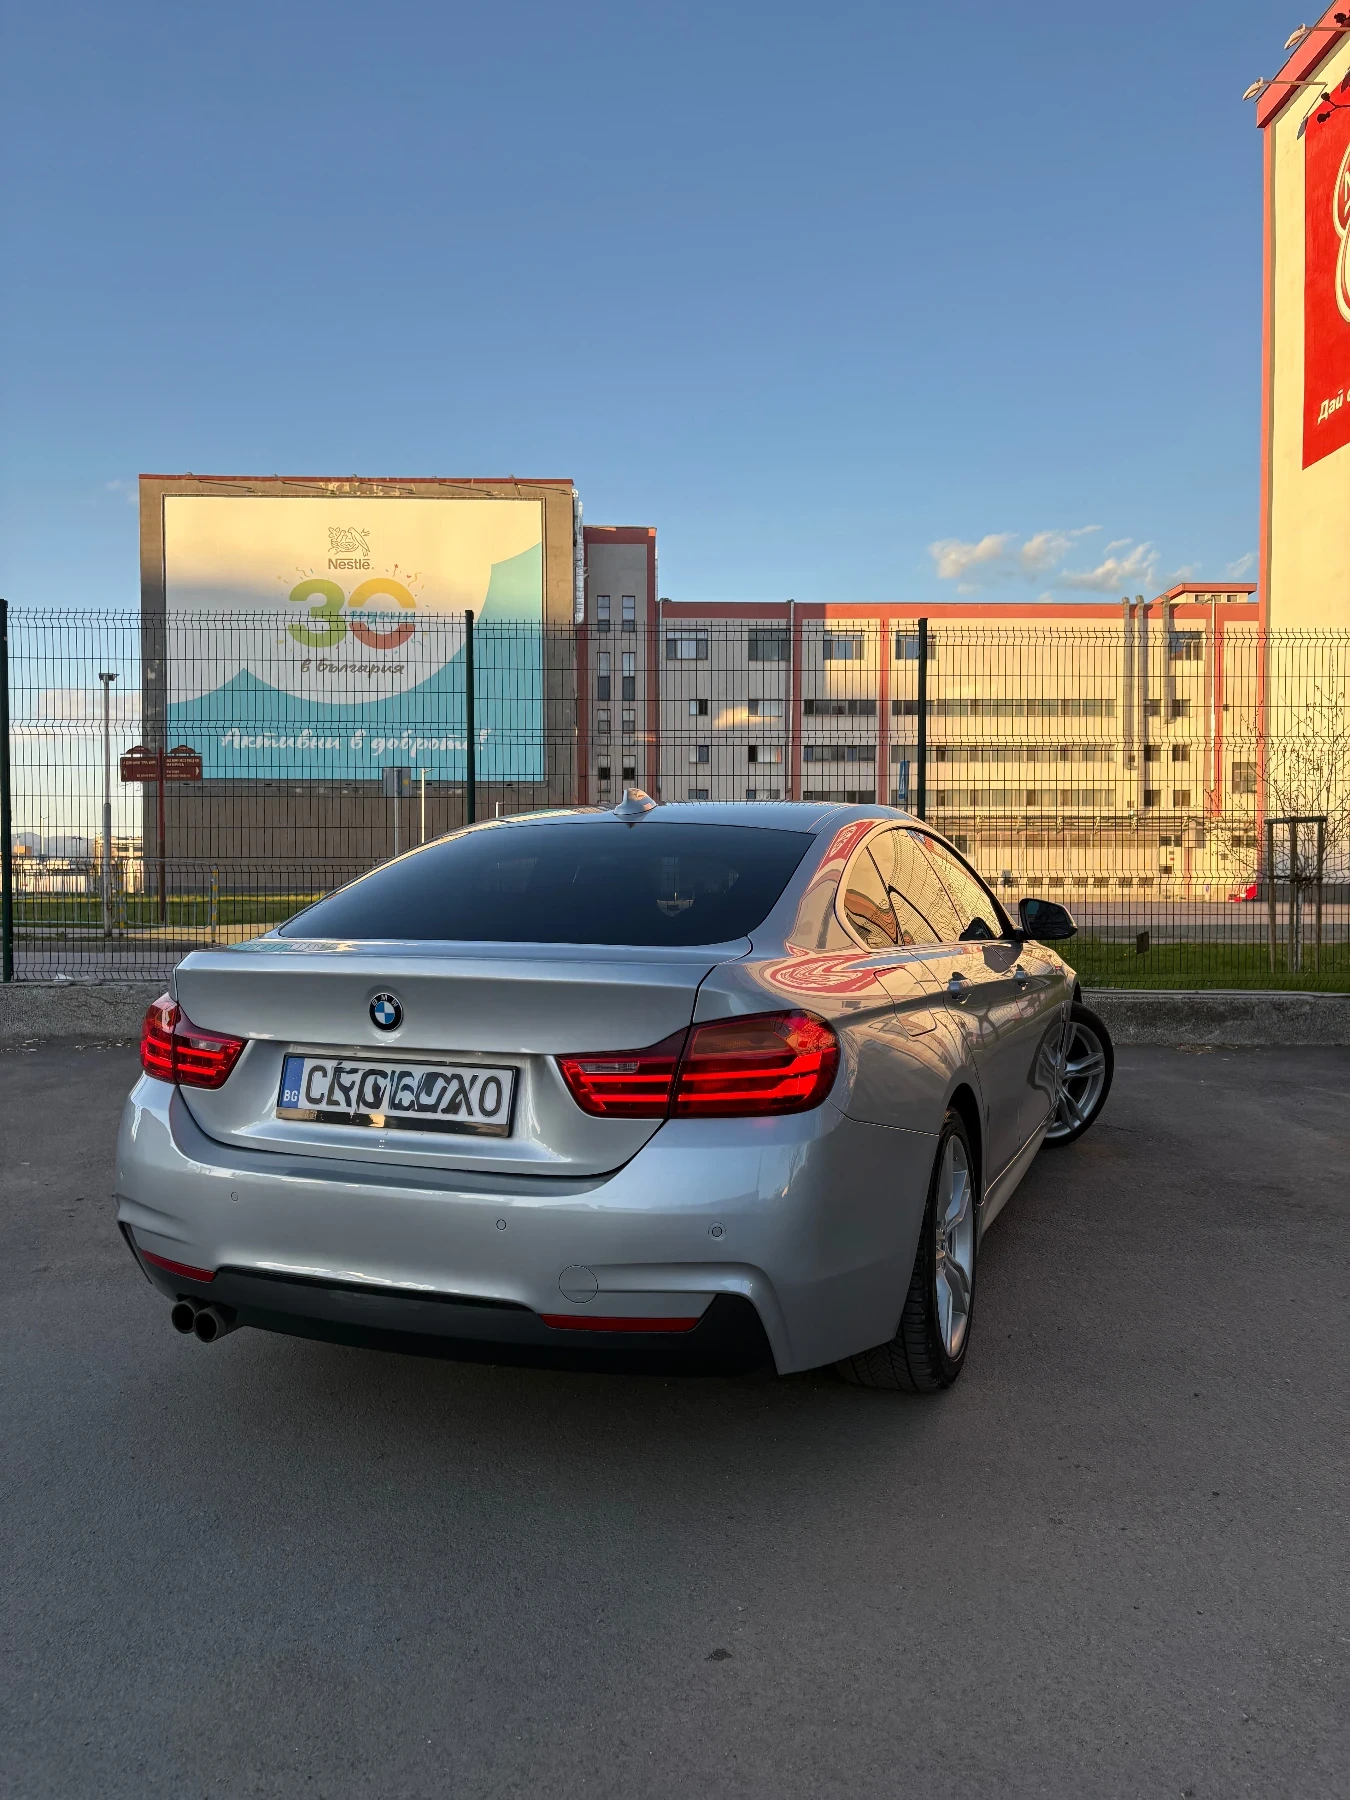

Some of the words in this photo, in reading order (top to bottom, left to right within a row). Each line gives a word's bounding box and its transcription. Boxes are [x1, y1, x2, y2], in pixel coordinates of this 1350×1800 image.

[1317, 388, 1344, 426] Дай
[287, 577, 417, 650] 30
[221, 728, 341, 749] Активни
[371, 994, 399, 1007] BMW
[283, 1089, 299, 1102] BG
